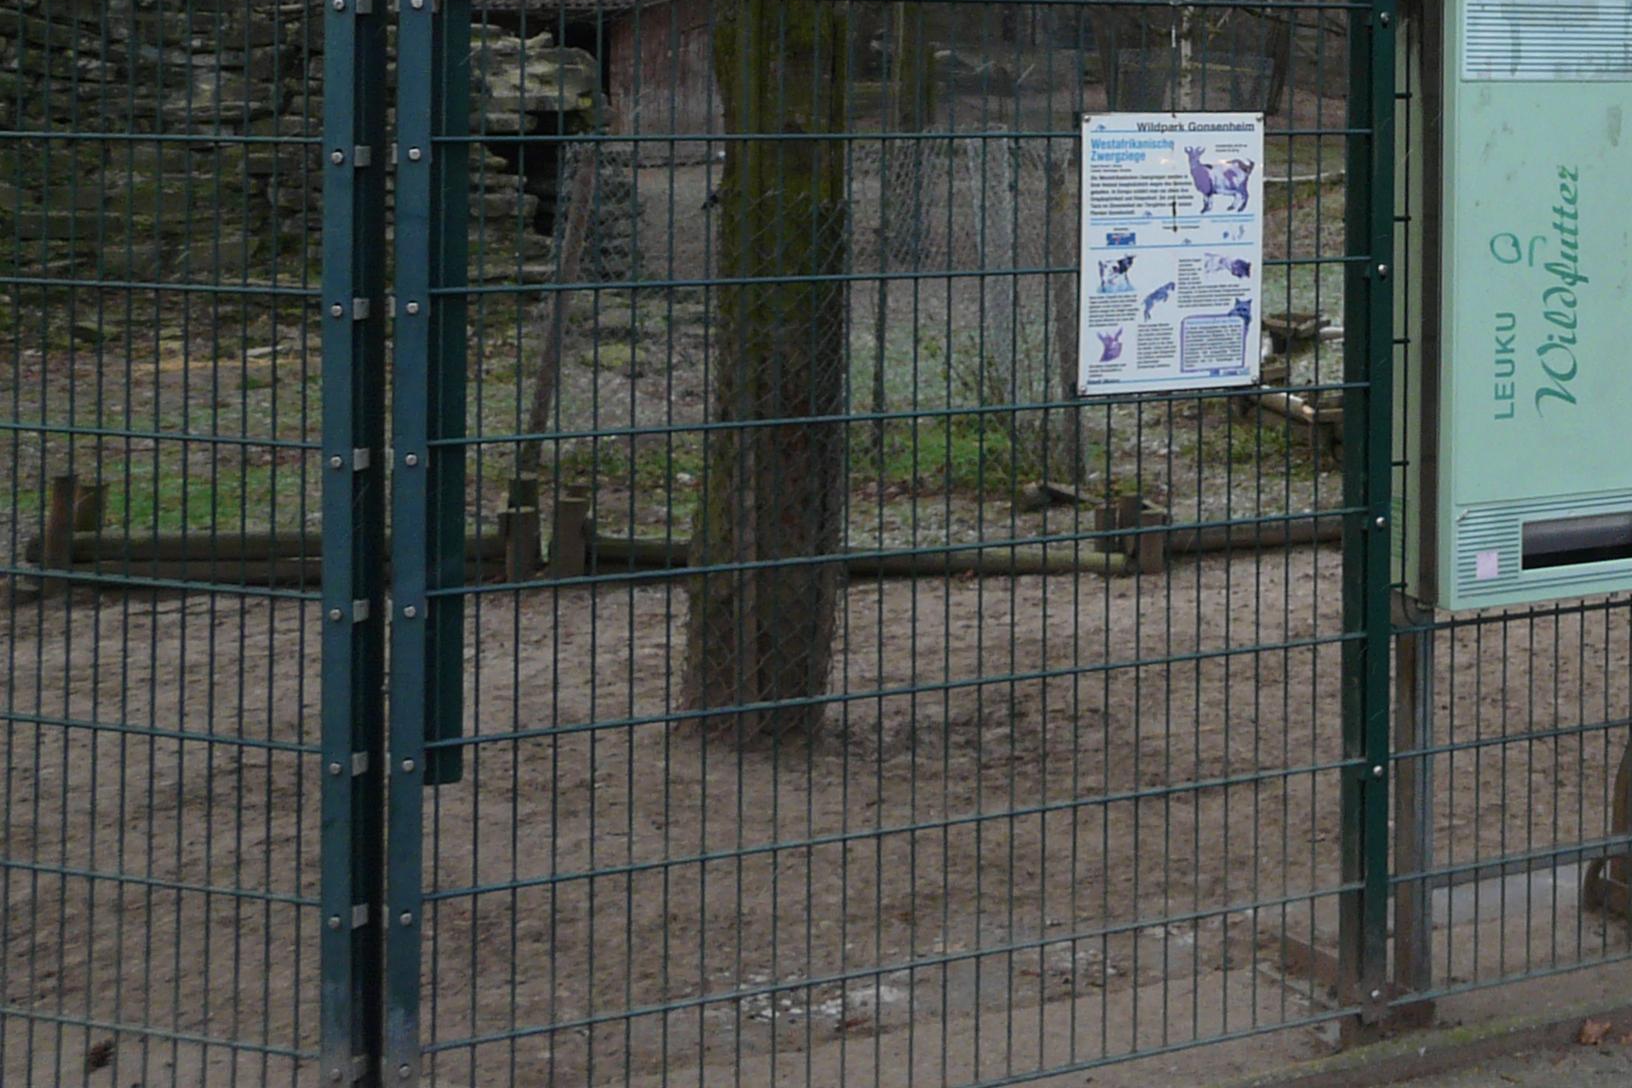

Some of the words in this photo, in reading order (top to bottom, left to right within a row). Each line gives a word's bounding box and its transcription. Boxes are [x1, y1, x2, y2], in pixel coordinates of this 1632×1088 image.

[1136, 122, 1185, 133] Wildpark
[1188, 121, 1255, 132] Gonsenheim
[1090, 138, 1175, 151] Westafrikanische
[1090, 150, 1146, 163] Zwergziege
[1534, 164, 1590, 419] Wildfutter
[1493, 311, 1516, 420] LEUKU
